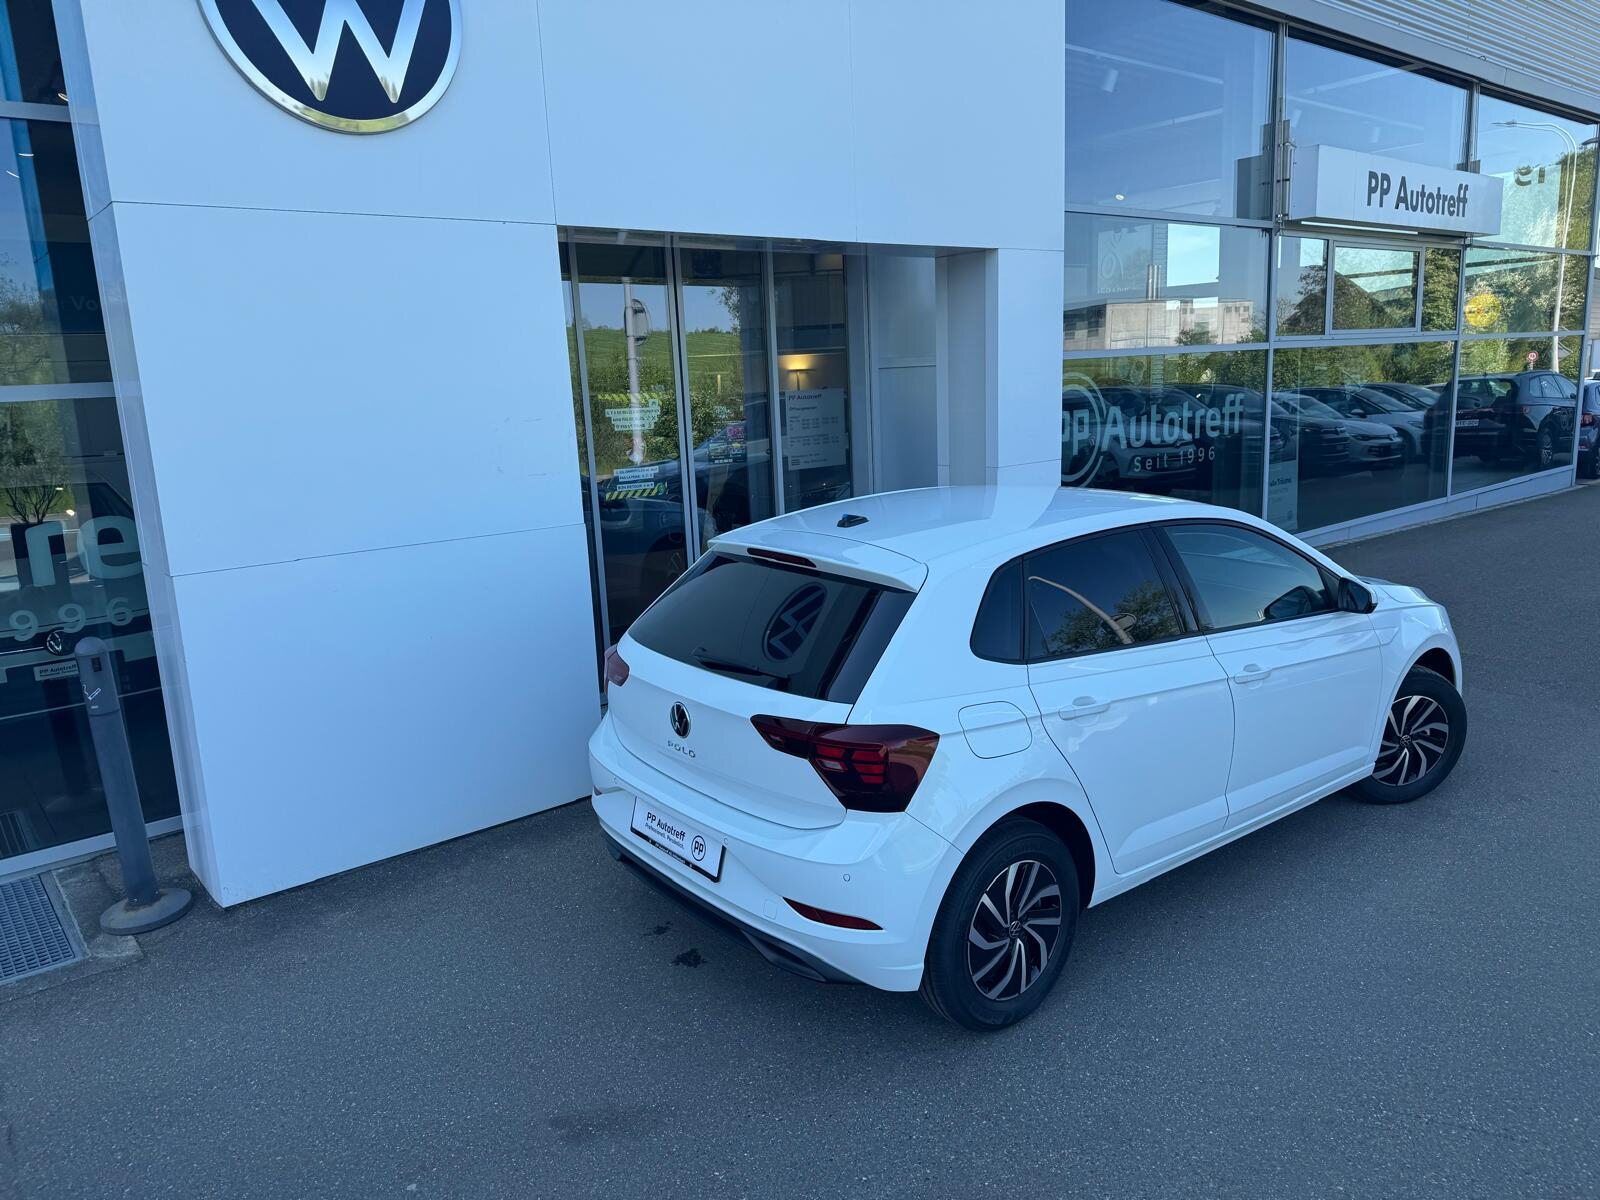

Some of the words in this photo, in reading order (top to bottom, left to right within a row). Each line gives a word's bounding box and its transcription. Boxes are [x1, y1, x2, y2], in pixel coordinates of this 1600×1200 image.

[1366, 170, 1392, 208] PP
[1395, 175, 1469, 218] Autotreff
[1101, 393, 1245, 452] Autotreff
[1133, 452, 1169, 473] Seit
[1179, 446, 1216, 466] 1996
[667, 740, 696, 758] POLO
[646, 811, 657, 824] PP
[657, 818, 686, 841] Autotreff
[693, 840, 704, 855] PP
